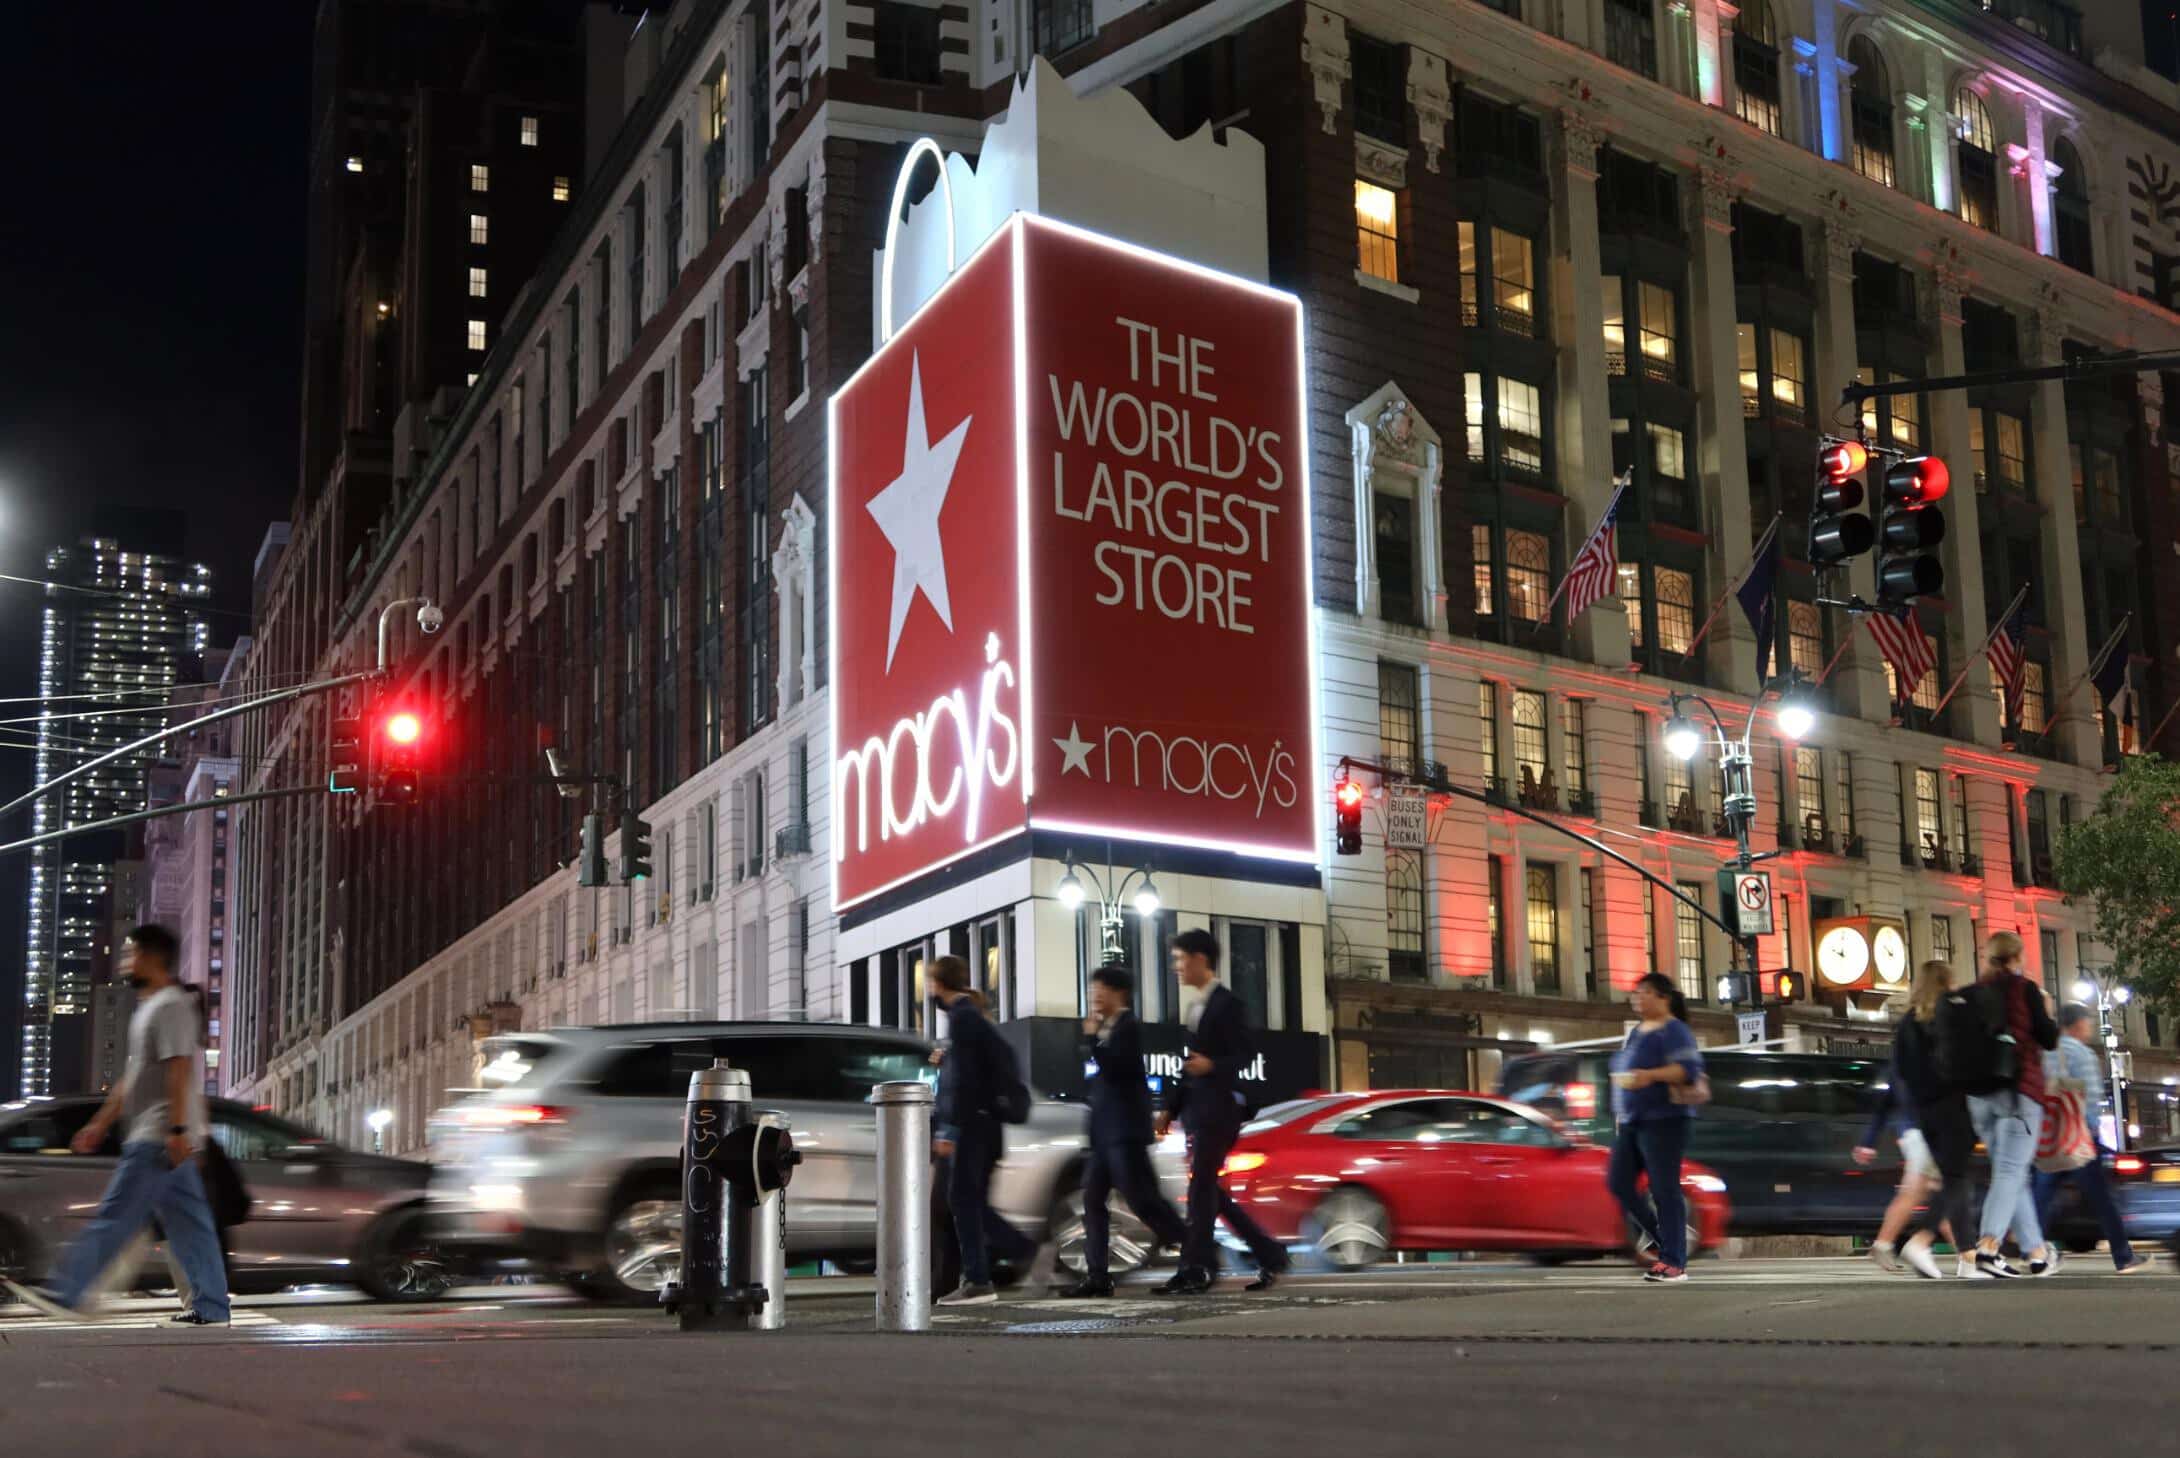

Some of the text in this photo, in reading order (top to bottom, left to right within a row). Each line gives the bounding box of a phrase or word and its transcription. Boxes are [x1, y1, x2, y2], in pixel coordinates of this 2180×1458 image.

[1115, 316, 1218, 402] THE
[1048, 374, 1284, 491] WORLD'S
[1053, 452, 1280, 562] LARGEST
[1095, 541, 1254, 634] STORE
[1391, 801, 1424, 813] BUSES
[1391, 831, 1422, 844] SIGNAL
[1393, 816, 1421, 828] ONLY
